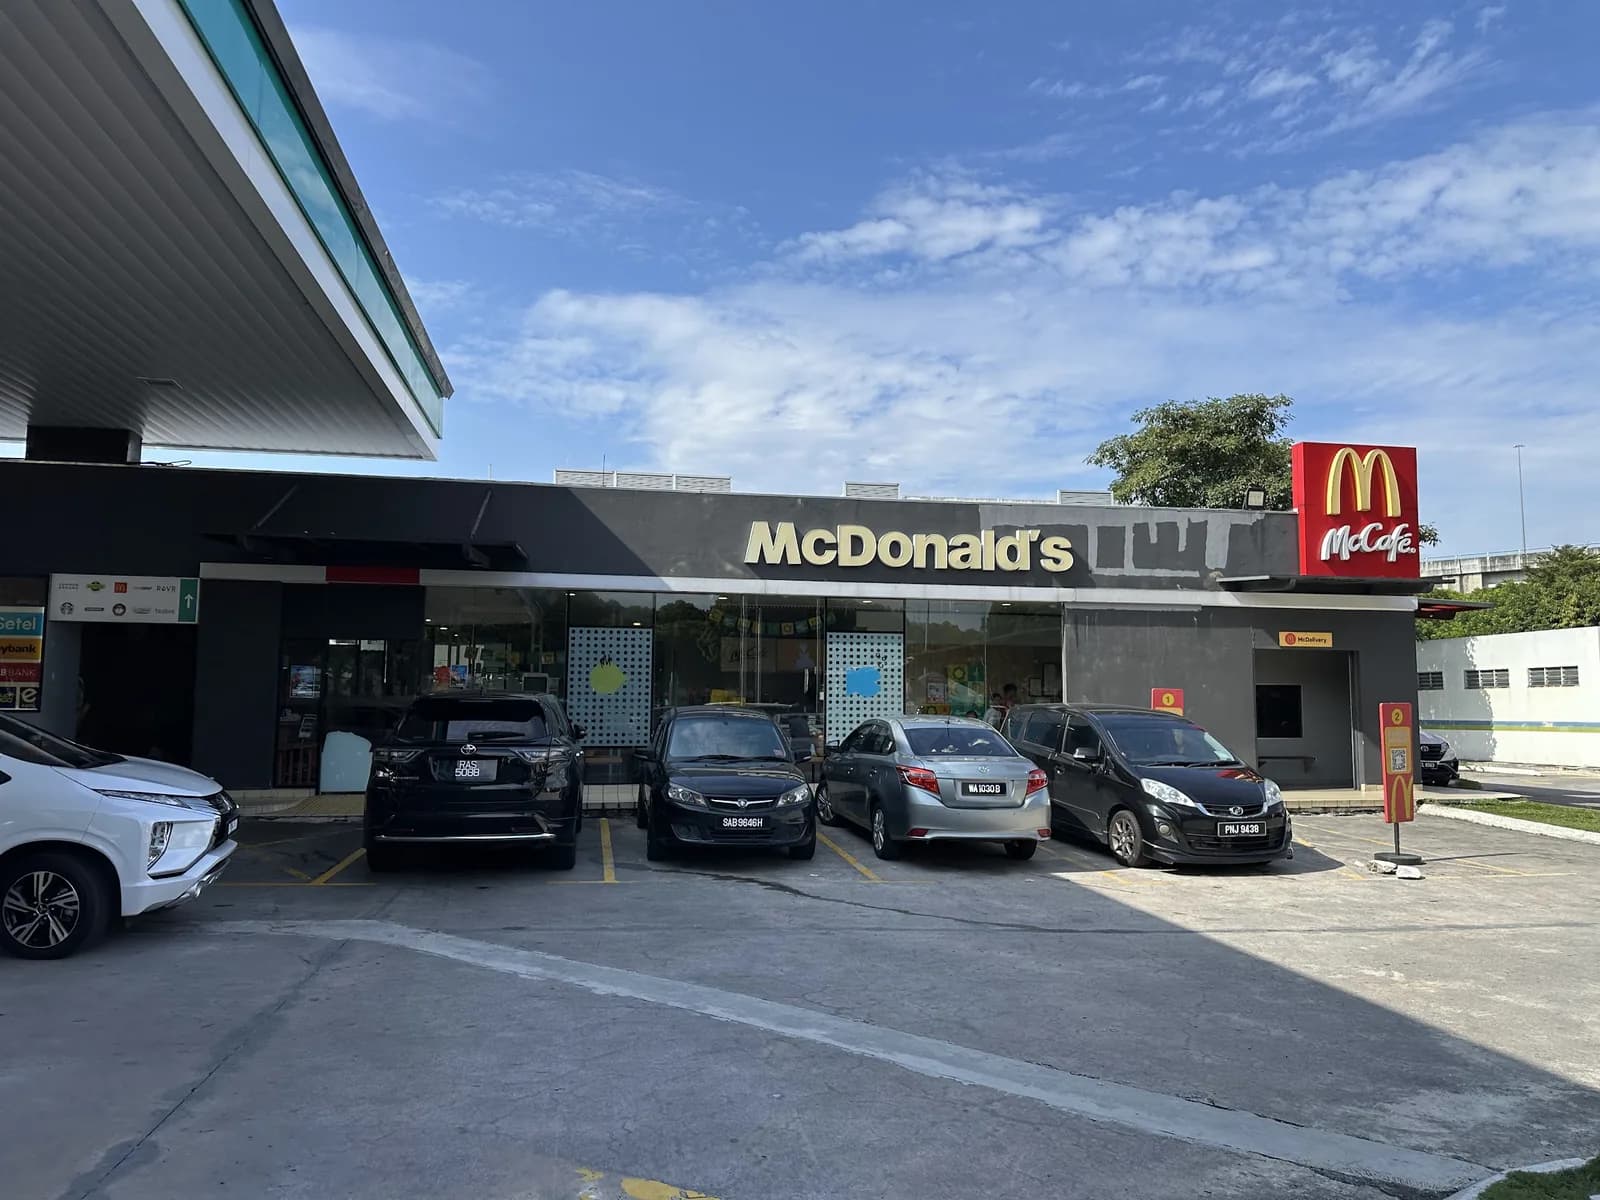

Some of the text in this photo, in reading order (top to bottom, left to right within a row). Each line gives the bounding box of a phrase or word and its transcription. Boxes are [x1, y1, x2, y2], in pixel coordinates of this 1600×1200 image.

[744, 521, 1074, 572] McDonald's
[0, 644, 36, 655] ybank
[1394, 712, 1400, 721] 2
